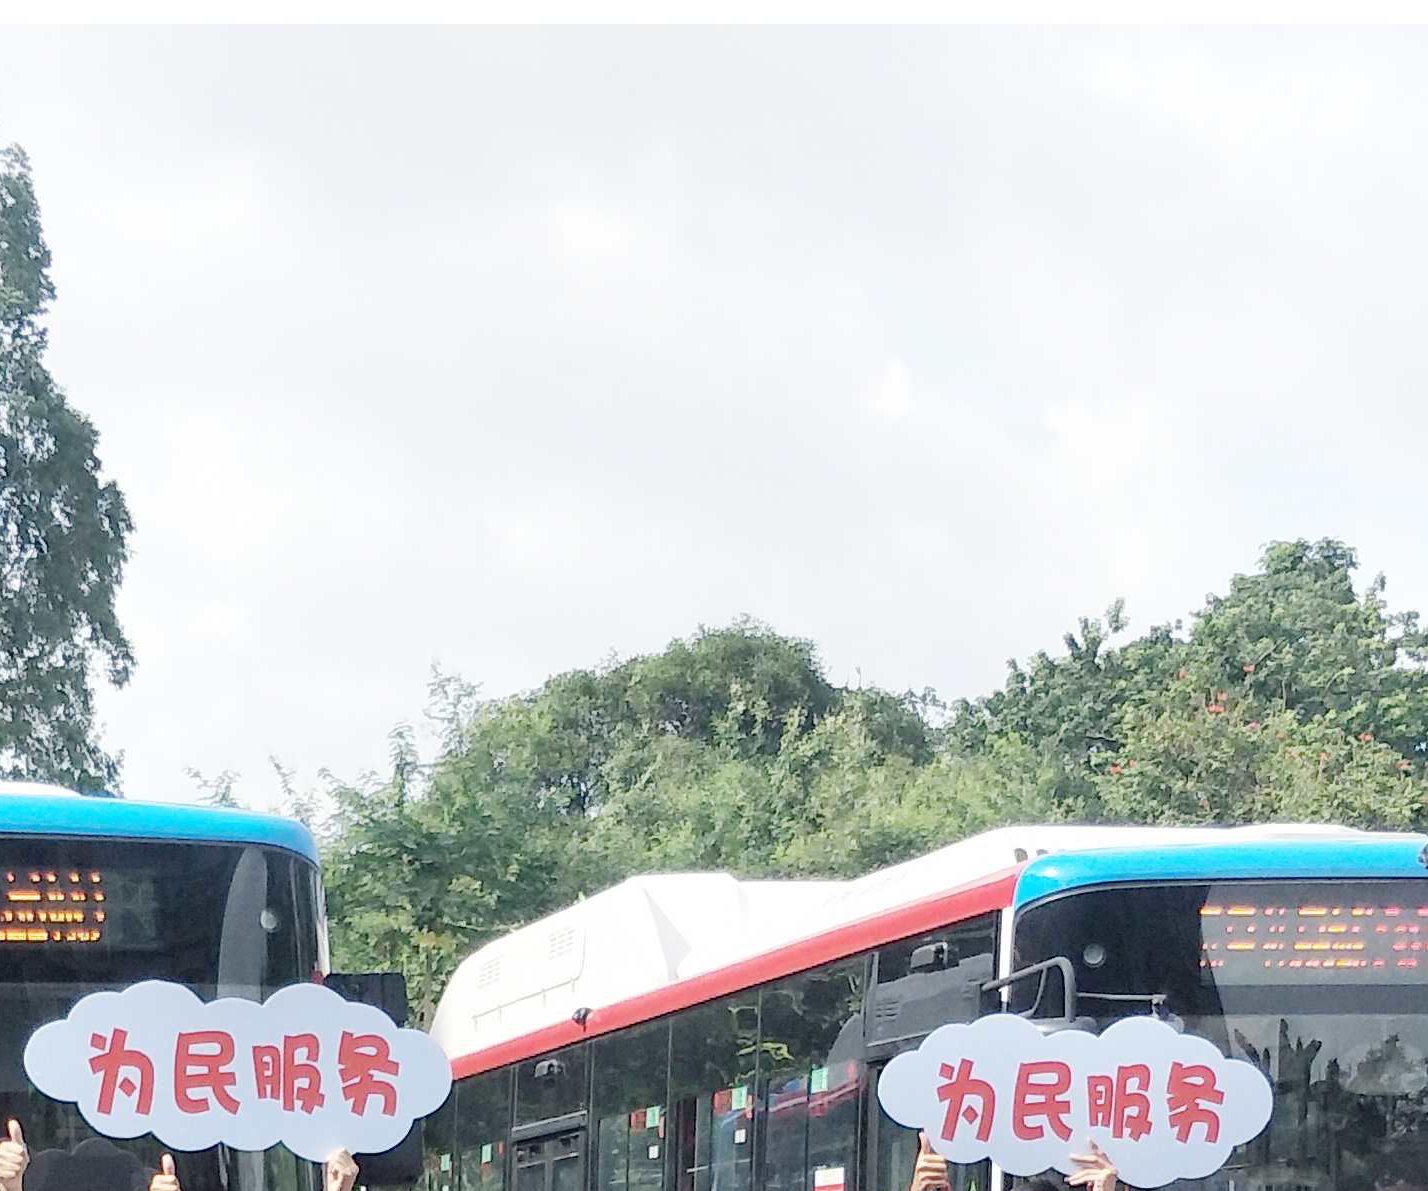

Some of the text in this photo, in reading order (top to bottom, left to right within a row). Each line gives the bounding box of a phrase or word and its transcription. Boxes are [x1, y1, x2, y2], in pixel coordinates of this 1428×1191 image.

[88, 1028, 400, 1117] 为民服务
[936, 1058, 1225, 1145] 为民服务
